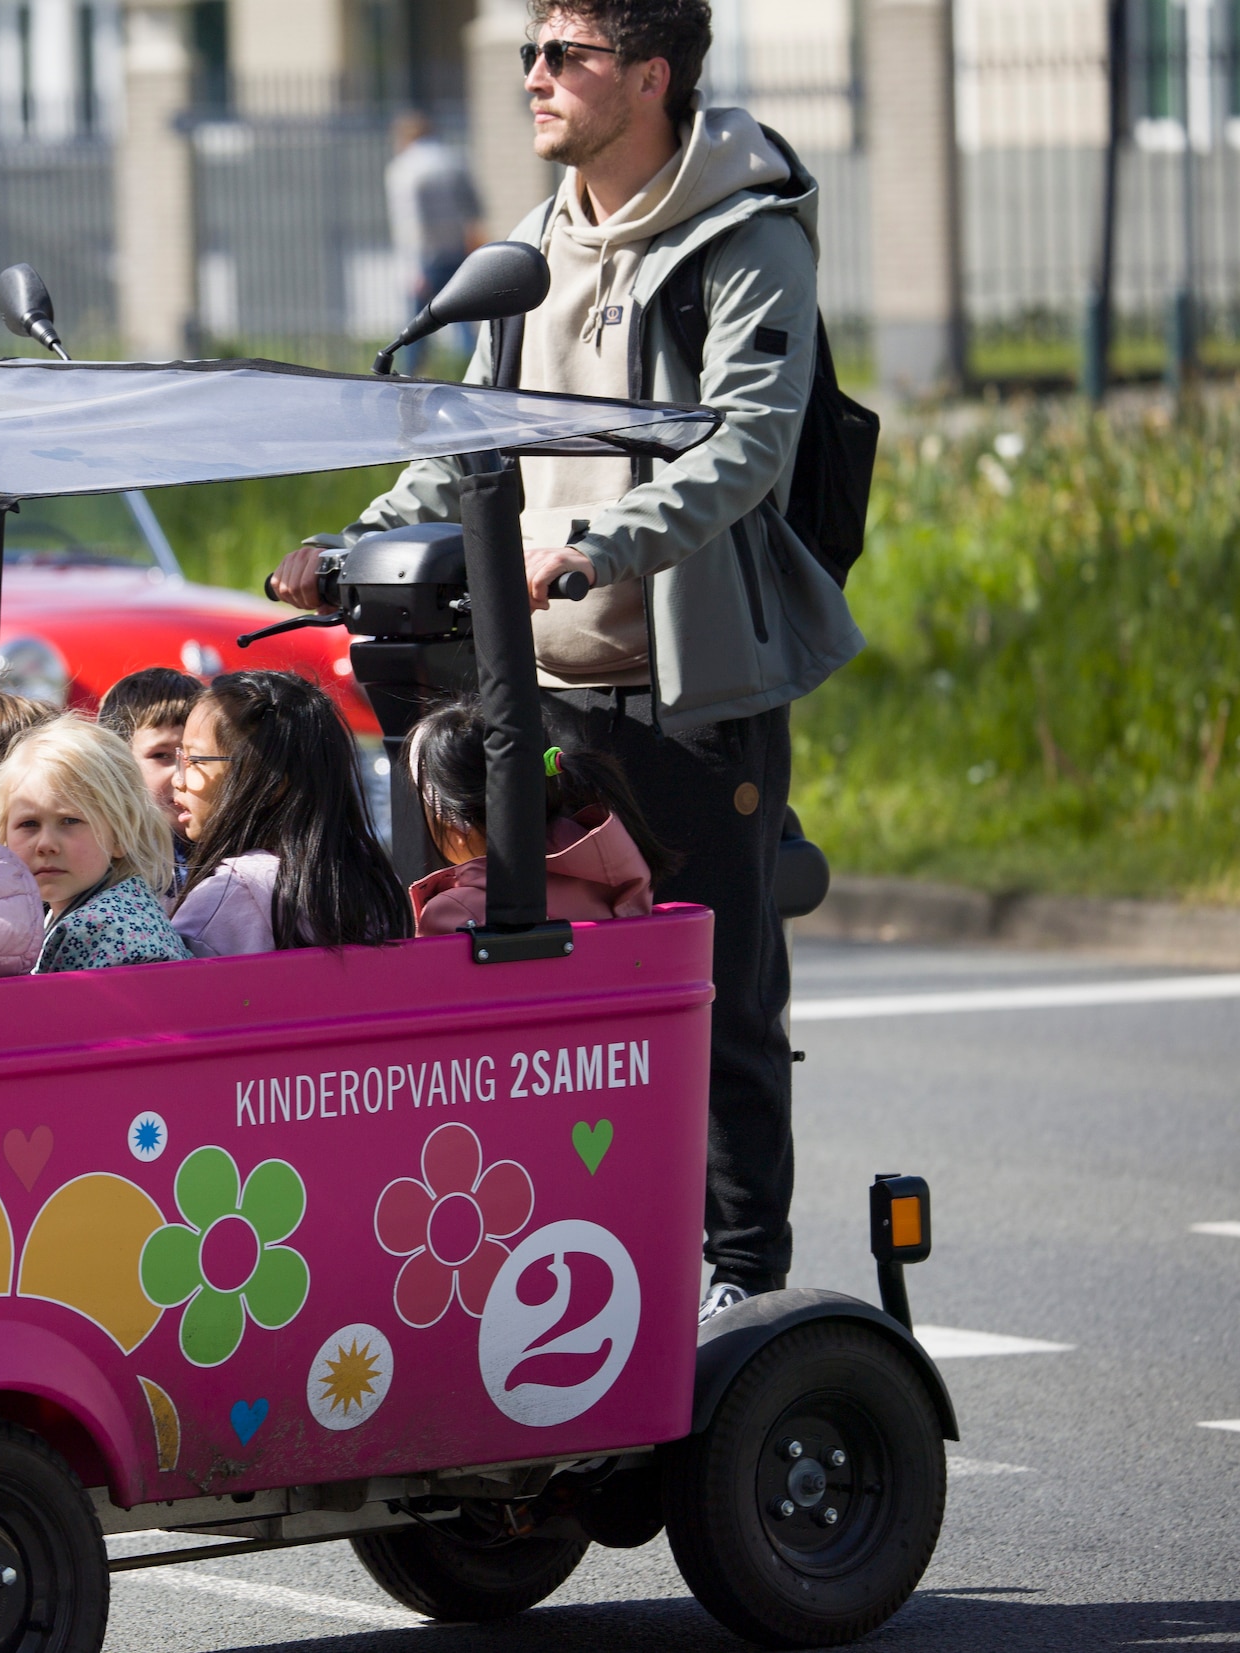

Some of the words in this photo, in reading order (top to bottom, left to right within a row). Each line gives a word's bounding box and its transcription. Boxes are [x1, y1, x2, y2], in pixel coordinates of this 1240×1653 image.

[235, 1055, 496, 1127] KINDEROPVANG
[509, 1039, 650, 1099] 2SAMEN
[504, 1250, 615, 1392] 2
